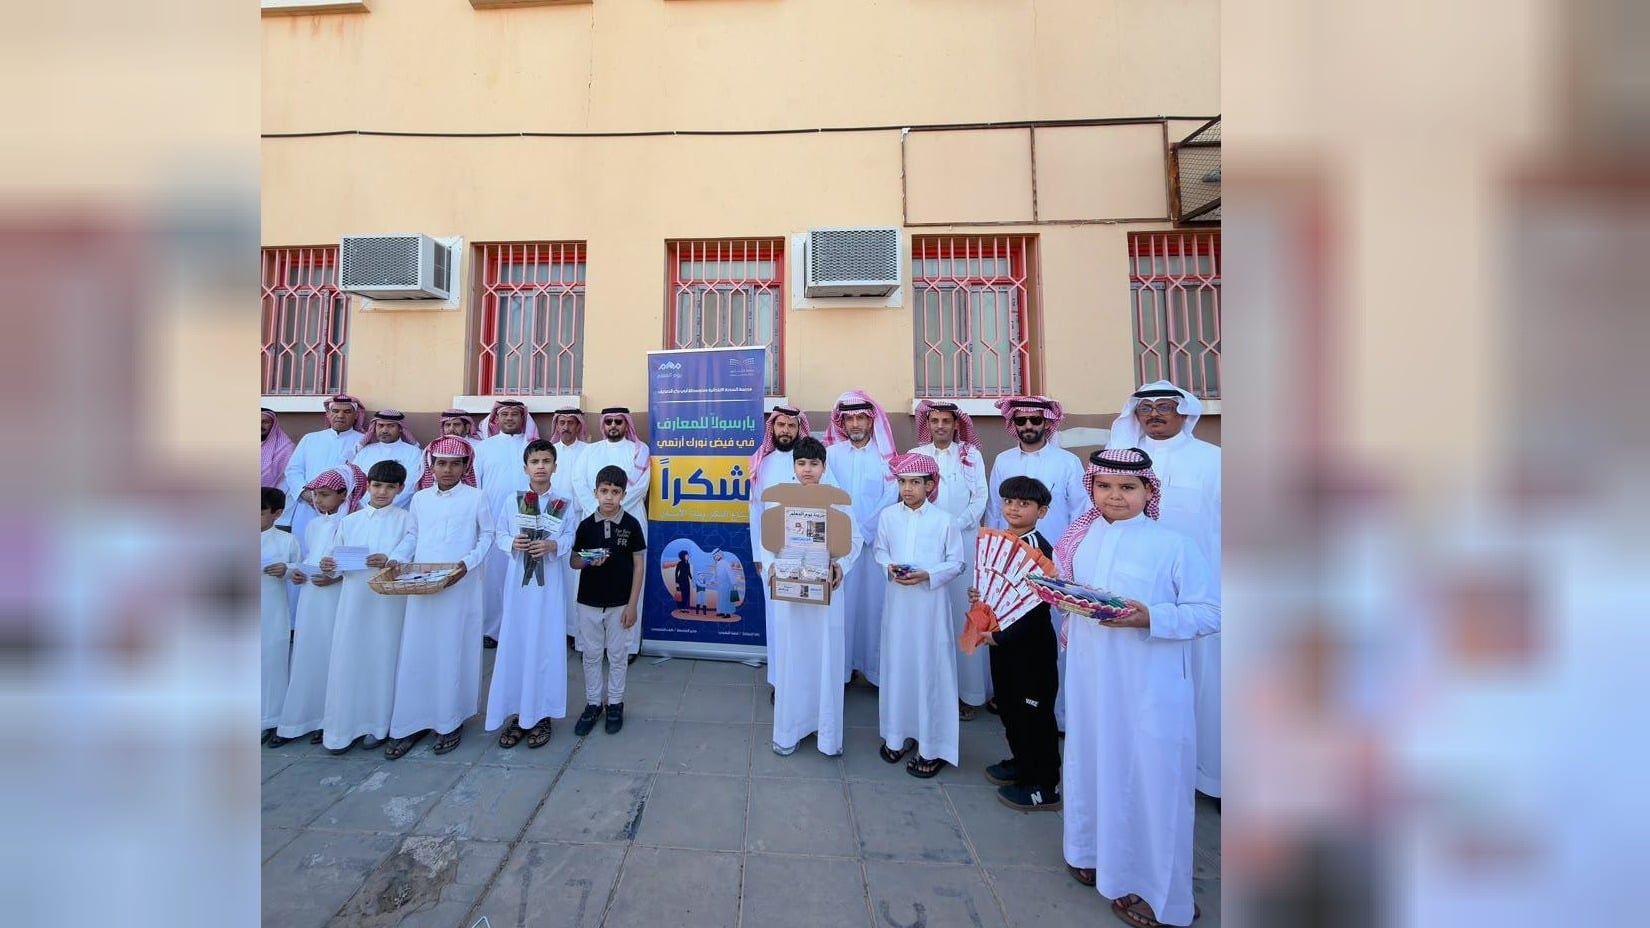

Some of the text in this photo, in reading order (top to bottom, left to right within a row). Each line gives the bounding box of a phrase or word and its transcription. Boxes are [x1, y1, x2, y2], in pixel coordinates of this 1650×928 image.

[656, 416, 709, 432] للمعارف
[686, 436, 708, 449] نورك
[709, 437, 735, 449] فيض
[736, 437, 755, 449] في
